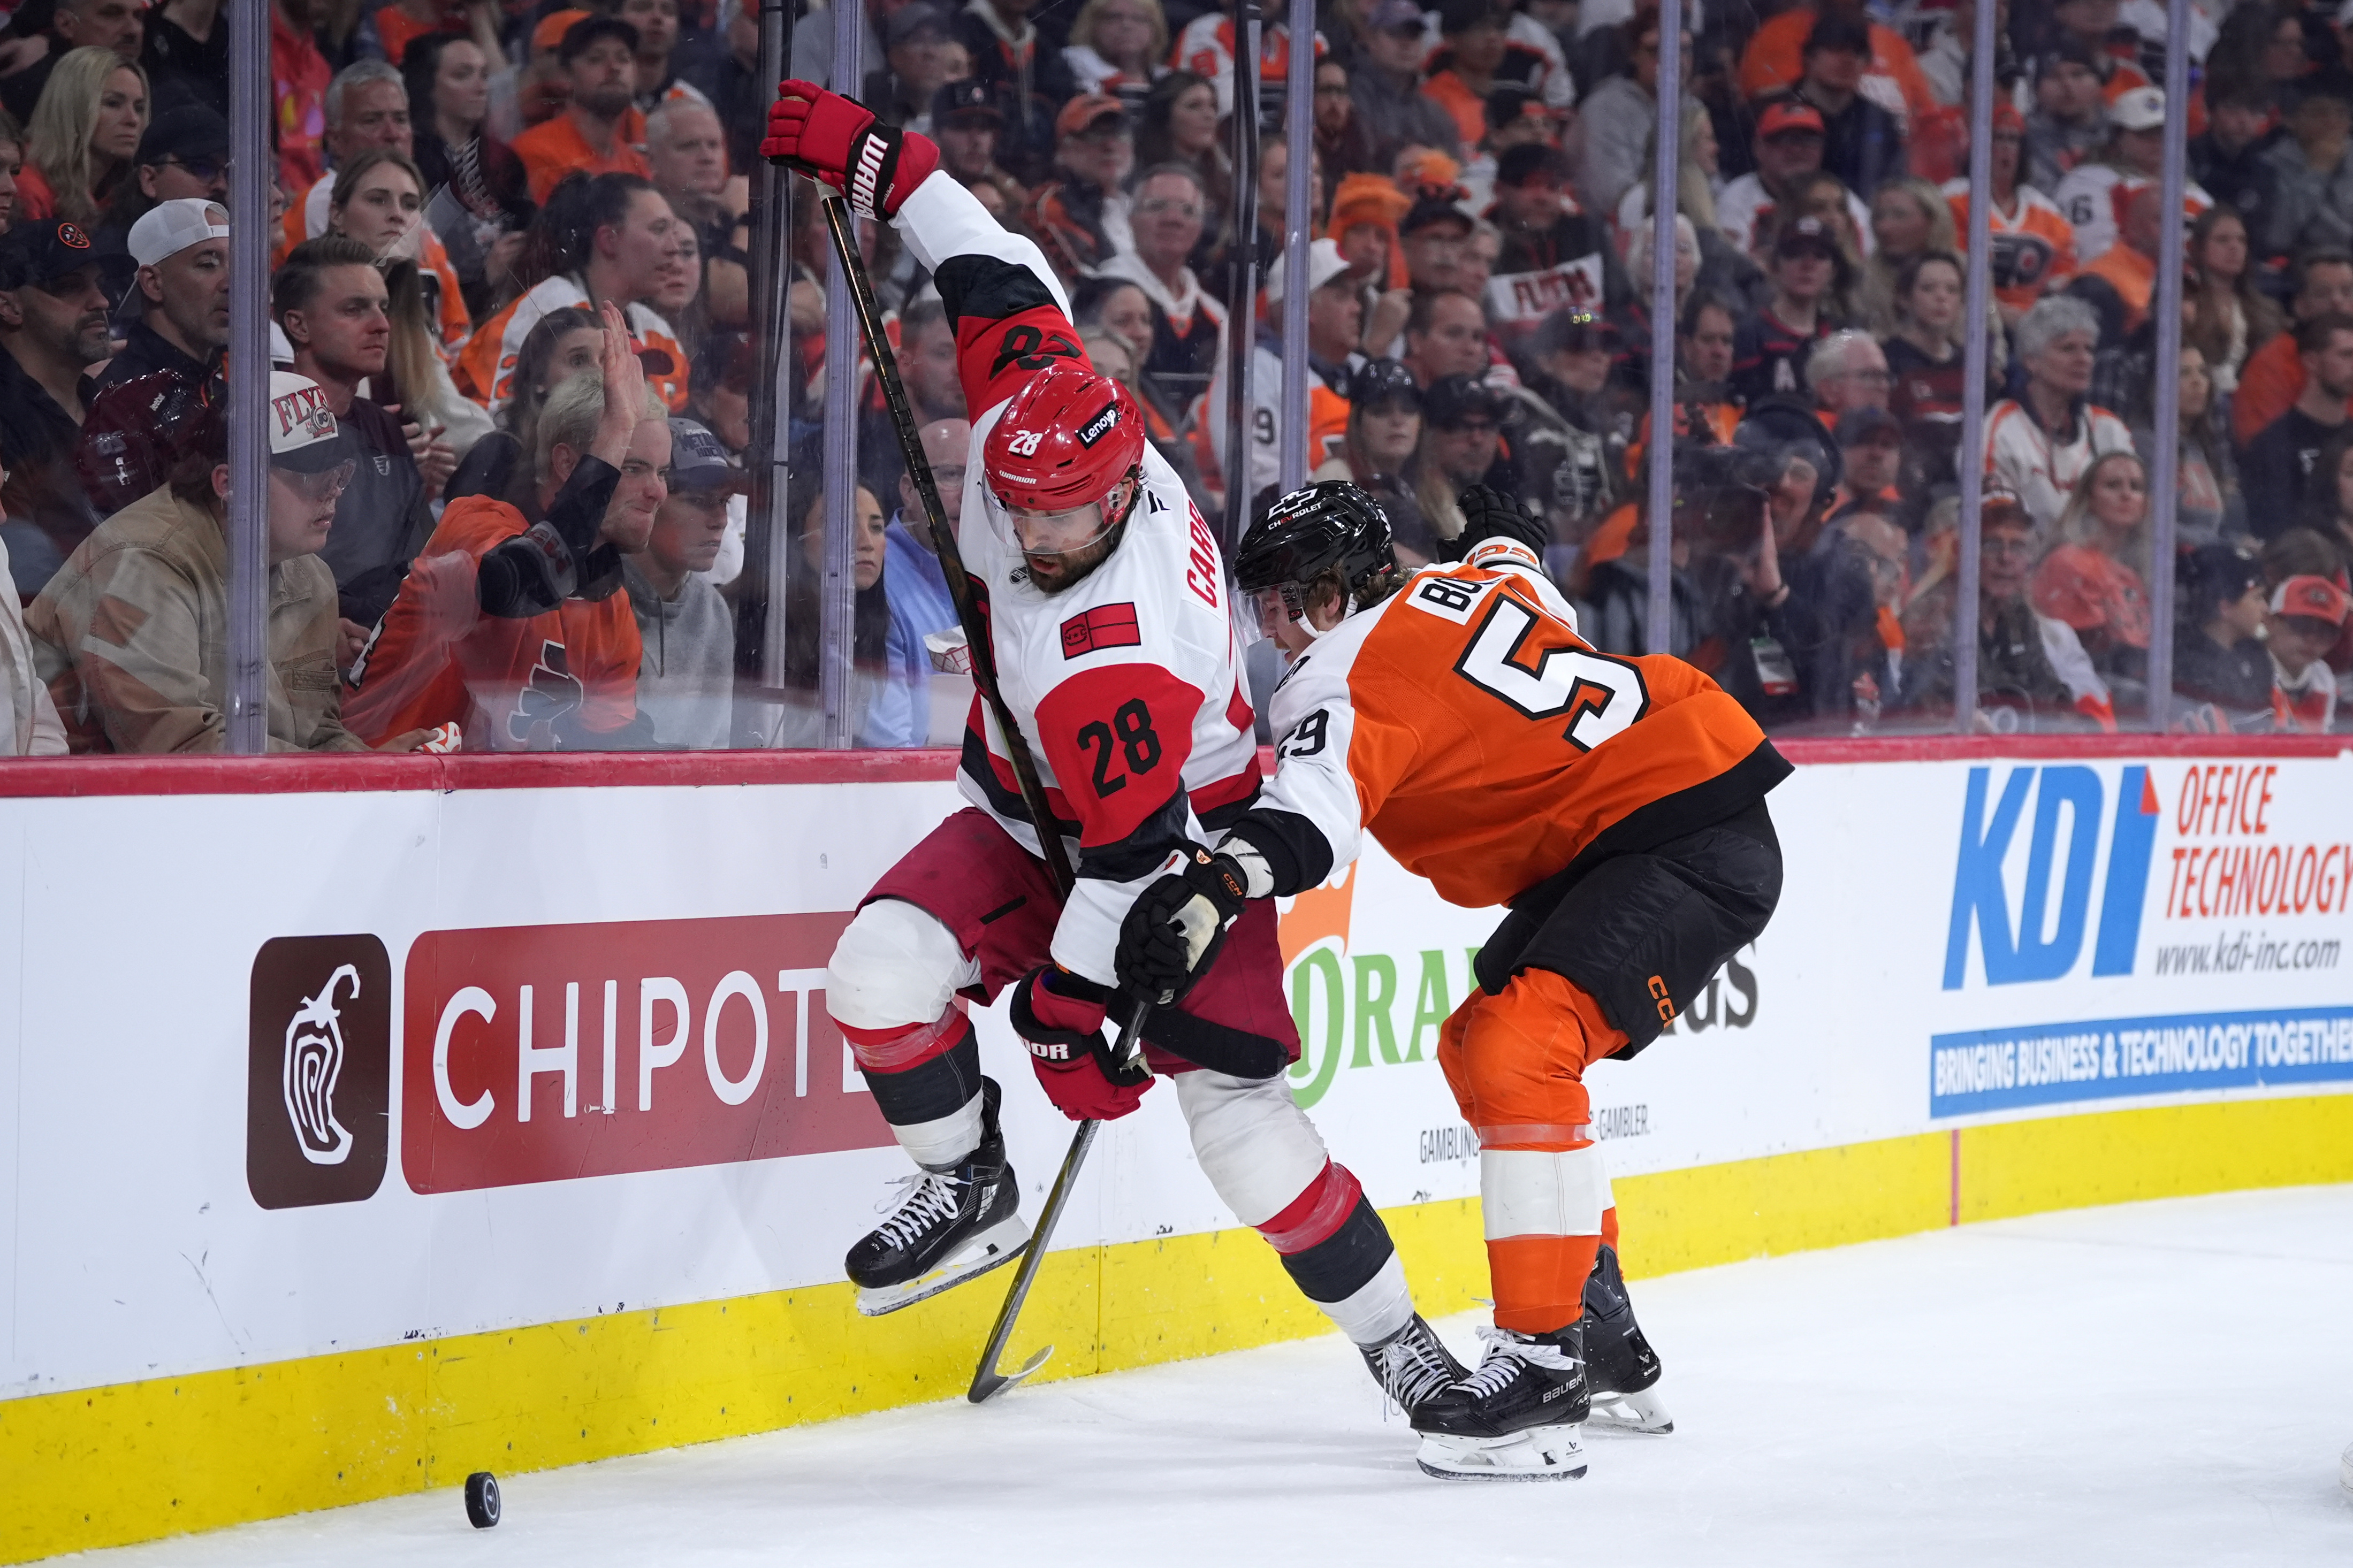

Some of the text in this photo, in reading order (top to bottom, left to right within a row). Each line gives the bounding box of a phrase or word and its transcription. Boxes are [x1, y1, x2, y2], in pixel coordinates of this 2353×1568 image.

[1008, 430, 1044, 456] 28
[1081, 409, 1116, 443] Lenovo
[999, 470, 1037, 485] WARRIOR
[1268, 502, 1322, 530] CHEVROLET
[1013, 570, 1025, 579] NHL
[1077, 698, 1162, 799] 28
[1223, 873, 1243, 896] CCM
[1942, 764, 2278, 991] KDI OFFICE
[2166, 844, 2353, 920] TECHNOLOGY
[2156, 930, 2341, 976] www.kdi-inc.com
[1935, 1041, 2015, 1097] BRINGING
[2016, 1033, 2100, 1087] BUSINESS
[2102, 1032, 2119, 1079] &
[2120, 1022, 2255, 1077] TECHNOLOGY
